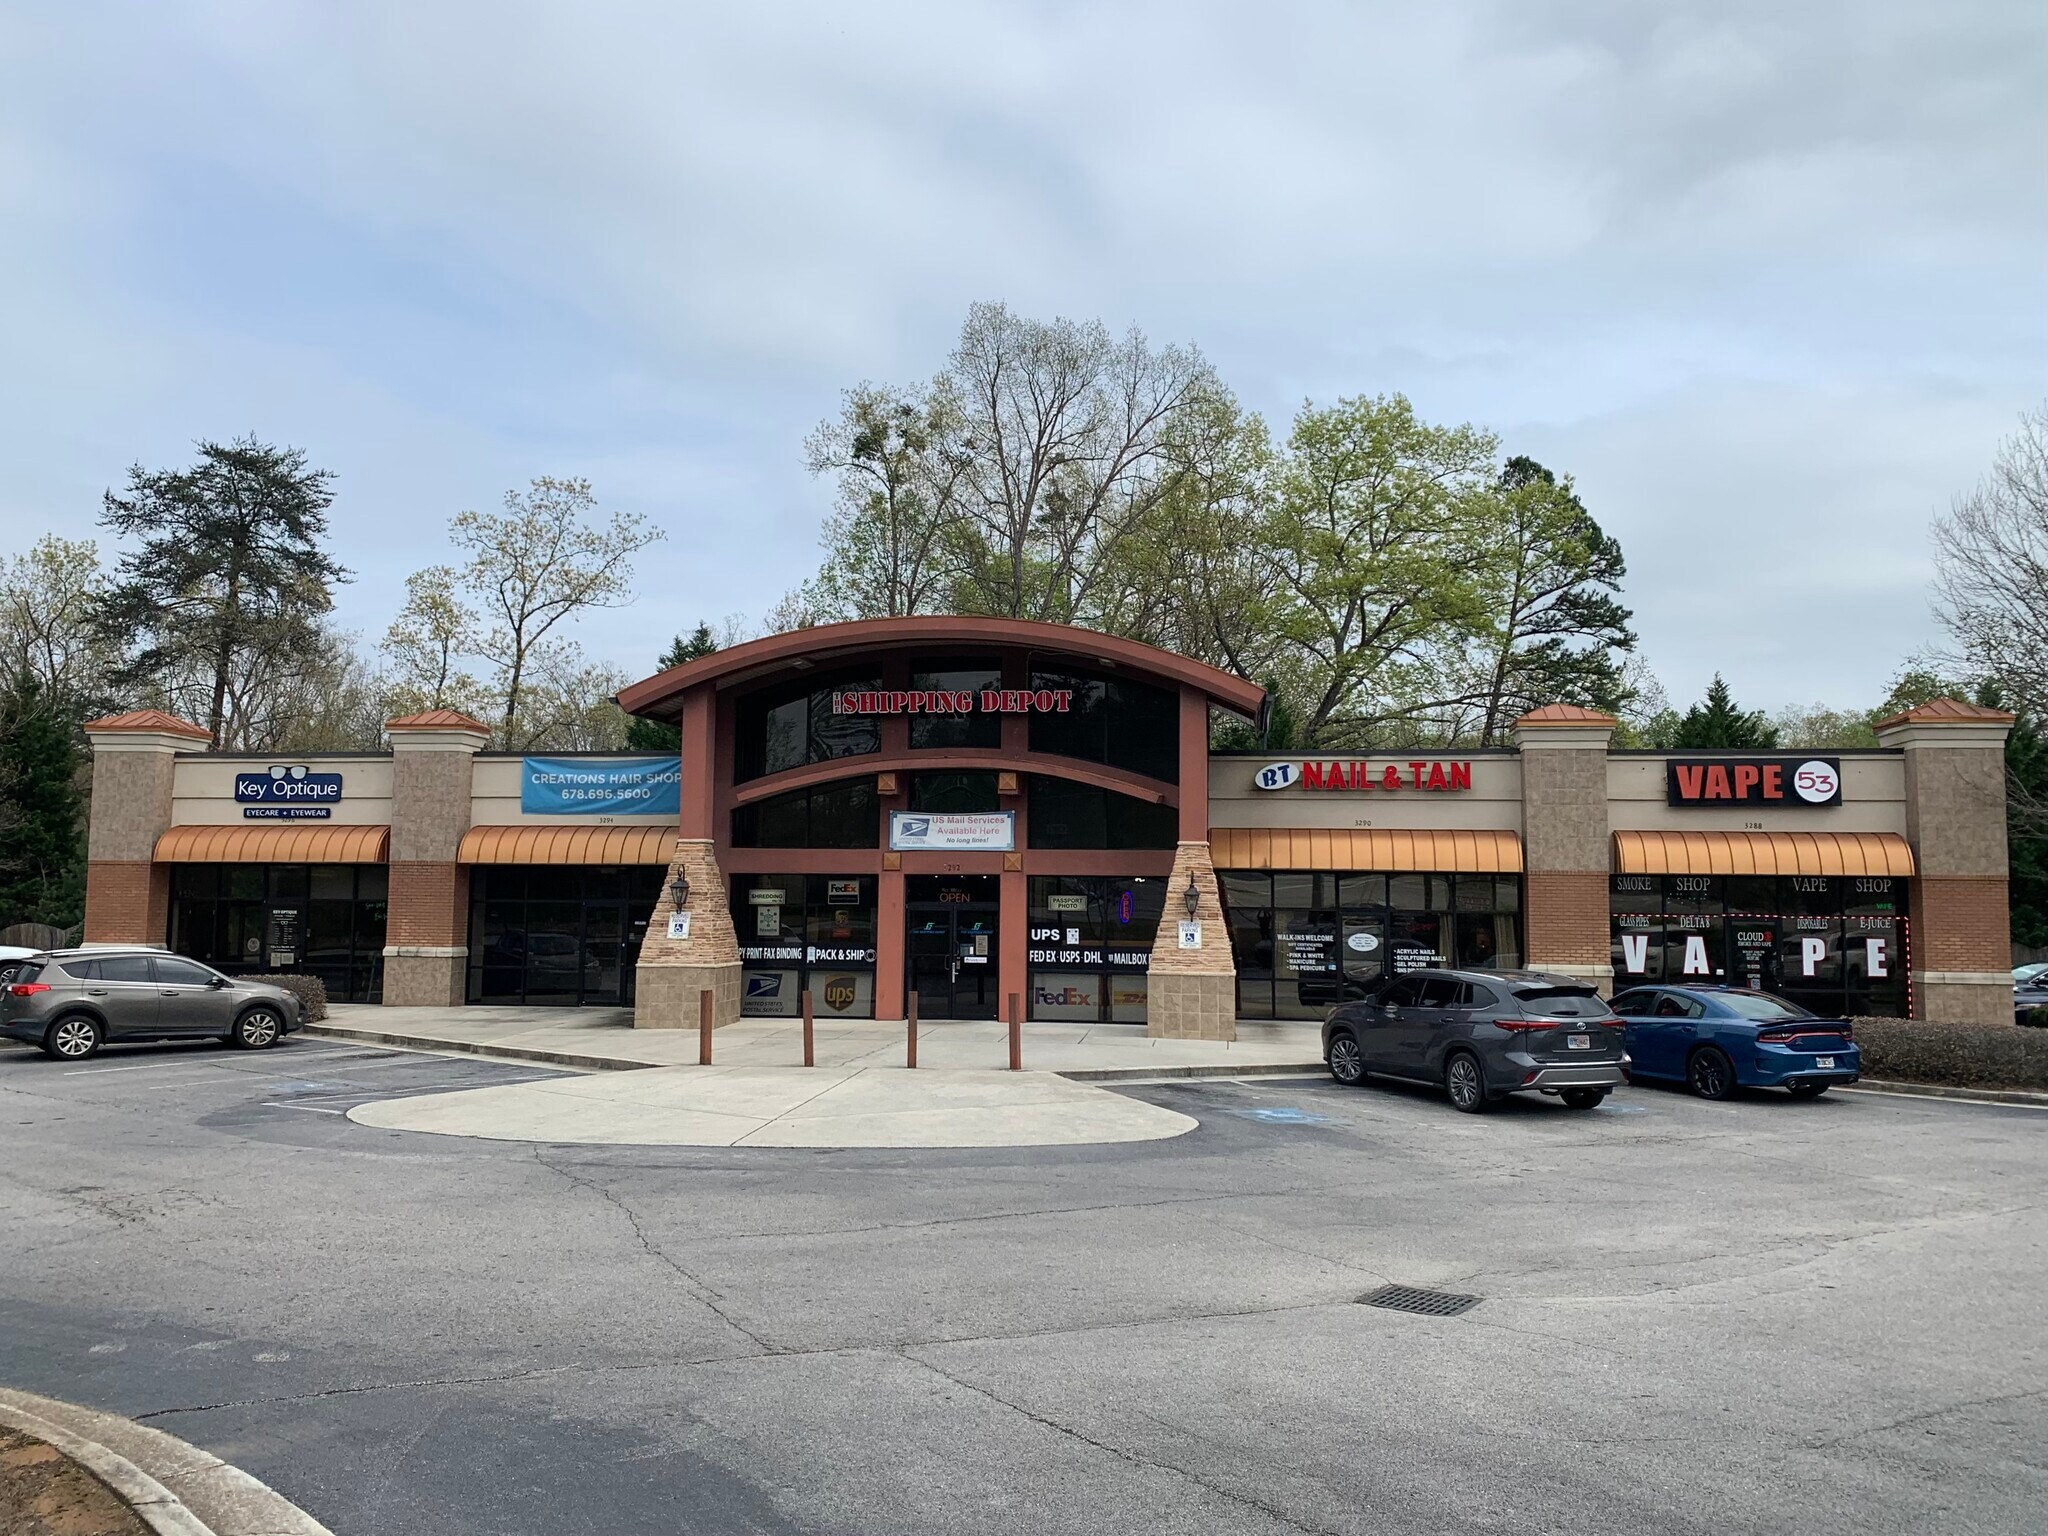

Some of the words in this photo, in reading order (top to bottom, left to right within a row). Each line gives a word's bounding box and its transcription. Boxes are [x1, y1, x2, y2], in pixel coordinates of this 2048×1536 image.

[833, 691, 842, 714] THE
[842, 690, 973, 713] SHIPPING
[981, 690, 1072, 713] DEPOT
[531, 773, 605, 784] CREATIONS
[609, 773, 642, 784] HAIR
[646, 772, 682, 784] SHOP
[1262, 764, 1290, 787] BT
[1302, 762, 1376, 790] NAIL
[1382, 765, 1402, 789] &
[1408, 762, 1471, 790] TAN
[1675, 765, 1783, 799] VAPE
[1798, 771, 1834, 793] 53
[238, 781, 267, 799] Key
[273, 780, 338, 799] Optique
[561, 788, 651, 800] 678.696.5600
[931, 816, 945, 824] US
[947, 816, 965, 824] Mail
[967, 816, 1005, 824] Services
[937, 827, 977, 835] Available
[980, 827, 1000, 835] Here
[943, 863, 961, 872] 292
[830, 883, 857, 893] FedEx
[1617, 876, 1652, 890] SMOKE
[1676, 877, 1710, 891] SHOP
[1793, 877, 1827, 892] VAPE
[1856, 878, 1891, 892] SHOP
[939, 893, 970, 902] OPEN
[1680, 917, 1704, 928] DELTA
[1860, 919, 1892, 929] E-JUICE
[1031, 929, 1060, 941] UPS
[1305, 934, 1334, 942] WELCOME
[1737, 931, 1764, 941] CLOUD
[763, 947, 775, 959] FAX
[776, 947, 803, 959] BINDING
[815, 949, 837, 960] PACK
[838, 950, 845, 960] &
[845, 950, 865, 960] SHIP
[1029, 950, 1045, 962] FED
[1046, 950, 1056, 962] EX
[1060, 950, 1080, 963] USPS
[1084, 951, 1103, 963] DHL
[1113, 953, 1148, 965] MAILBOX
[827, 987, 854, 1007] ups
[1034, 987, 1090, 1006] FedEx
